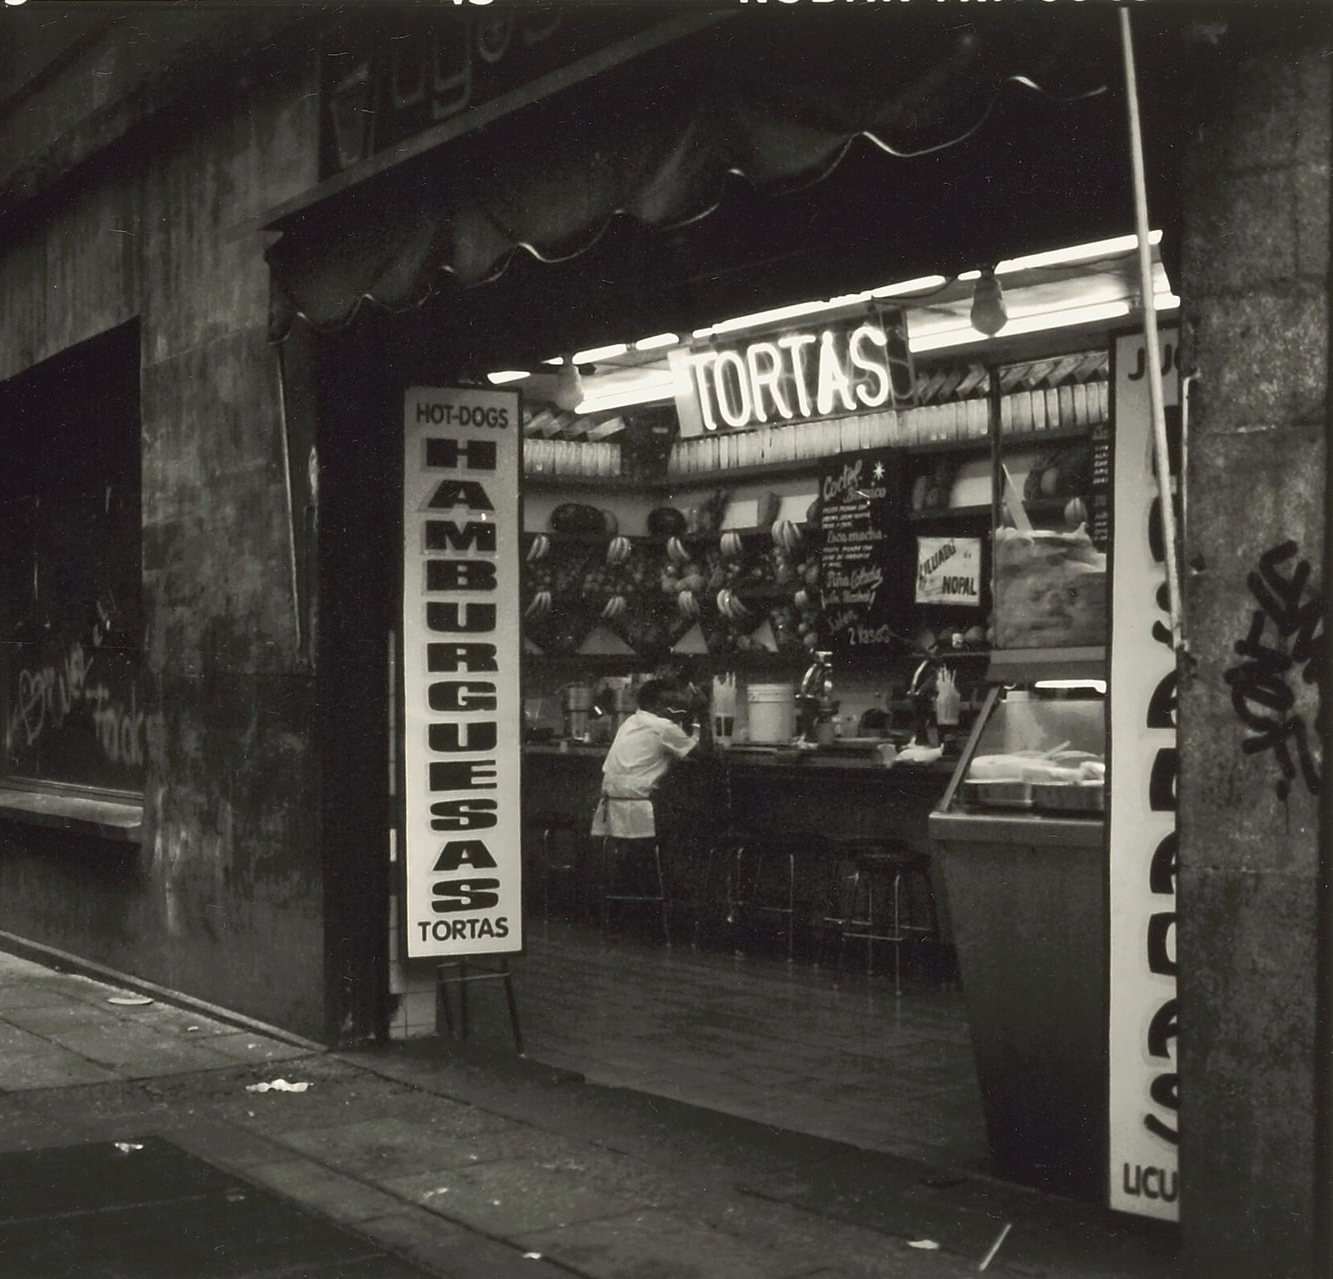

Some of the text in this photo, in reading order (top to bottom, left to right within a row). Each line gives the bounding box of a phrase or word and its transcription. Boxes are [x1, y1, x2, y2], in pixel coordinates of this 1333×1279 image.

[685, 325, 890, 431] TORTAS
[1128, 344, 1181, 381] JU
[416, 402, 509, 429] HOT-DOGS
[942, 576, 977, 595] NOPAL
[425, 437, 501, 914] HAMBURGUESAS
[417, 917, 510, 942] TORTAS
[1123, 1162, 1179, 1203] LICU
